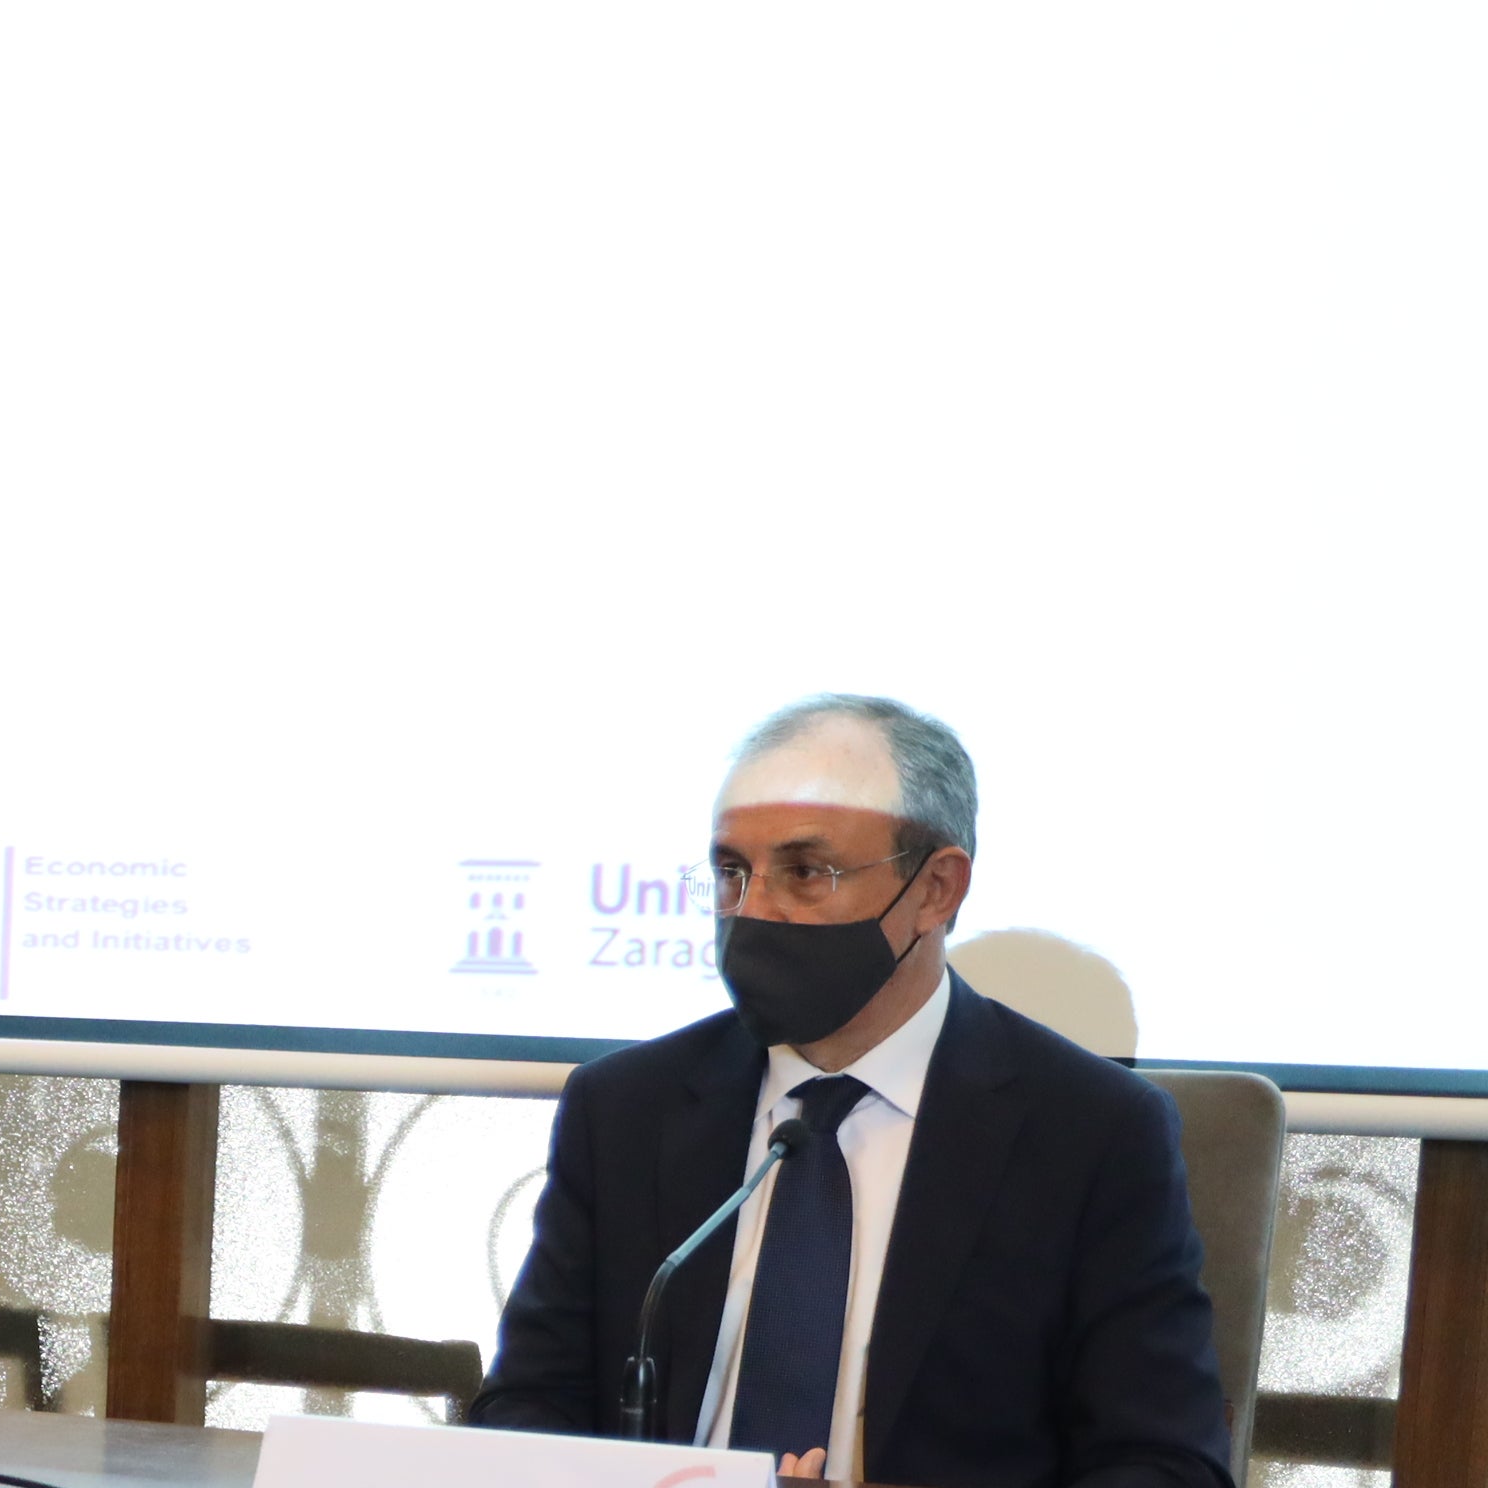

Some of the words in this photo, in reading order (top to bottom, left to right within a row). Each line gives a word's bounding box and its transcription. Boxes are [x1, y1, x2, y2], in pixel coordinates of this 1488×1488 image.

[24, 856, 187, 879] Economic
[24, 892, 188, 919] Strategies
[21, 928, 79, 950] and
[91, 928, 252, 956] Initiatives
